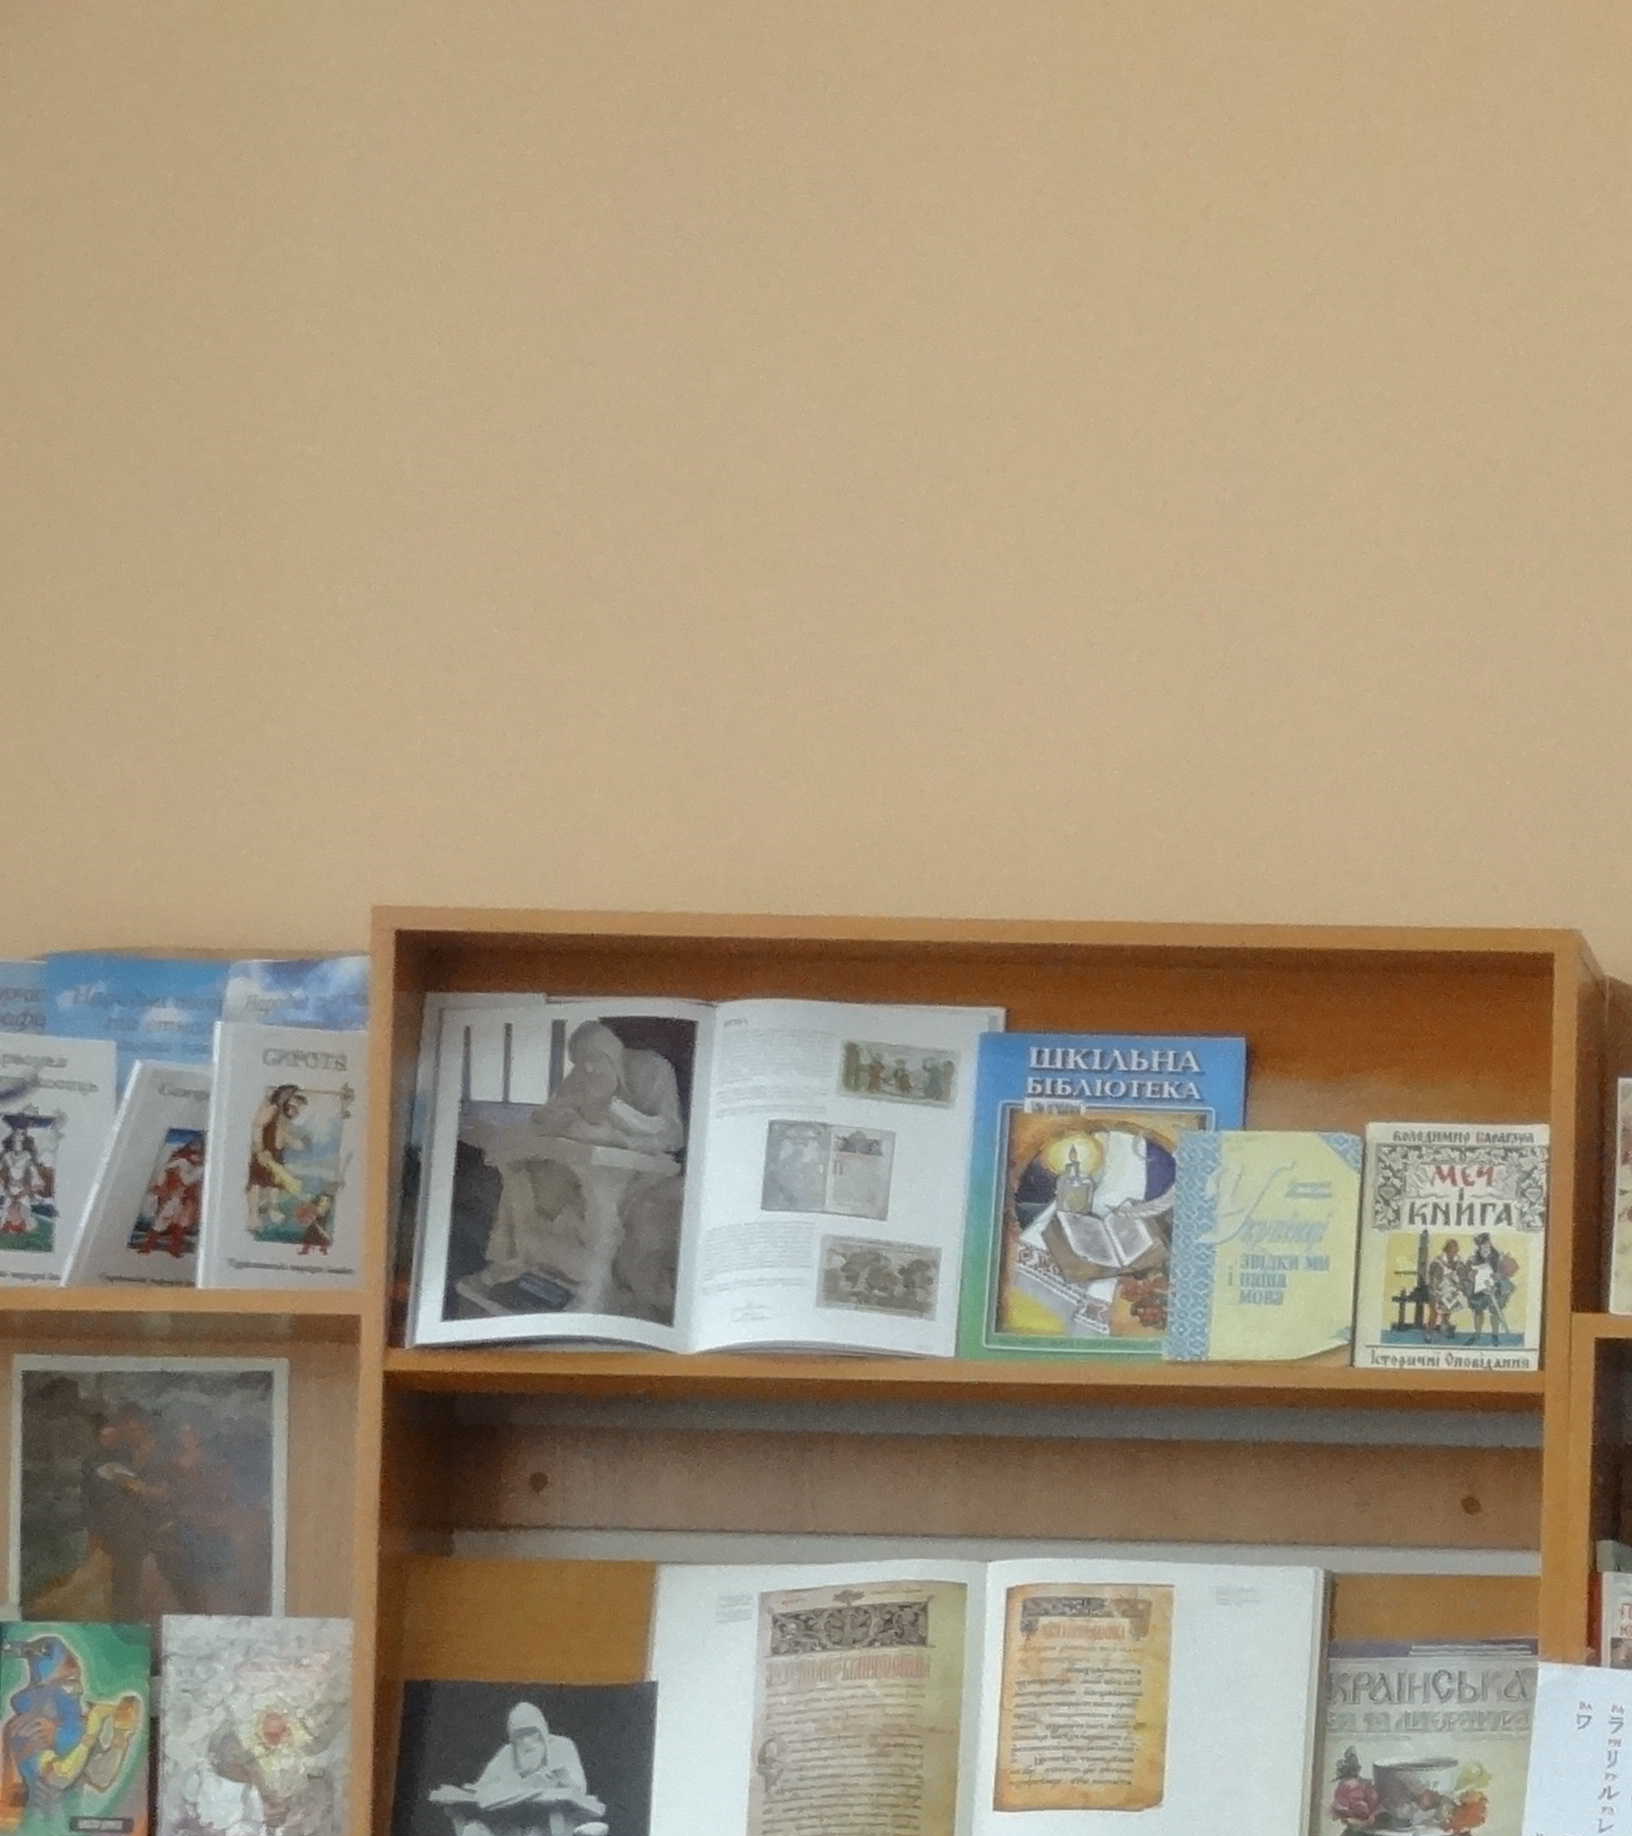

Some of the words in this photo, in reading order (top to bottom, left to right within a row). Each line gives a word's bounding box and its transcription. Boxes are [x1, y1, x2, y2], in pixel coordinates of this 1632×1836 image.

[1028, 1046, 1202, 1073] ШКІЛЬНА
[1026, 1077, 1203, 1100] БІБЛІОТЕКА
[1407, 1201, 1516, 1228] КНИГА
